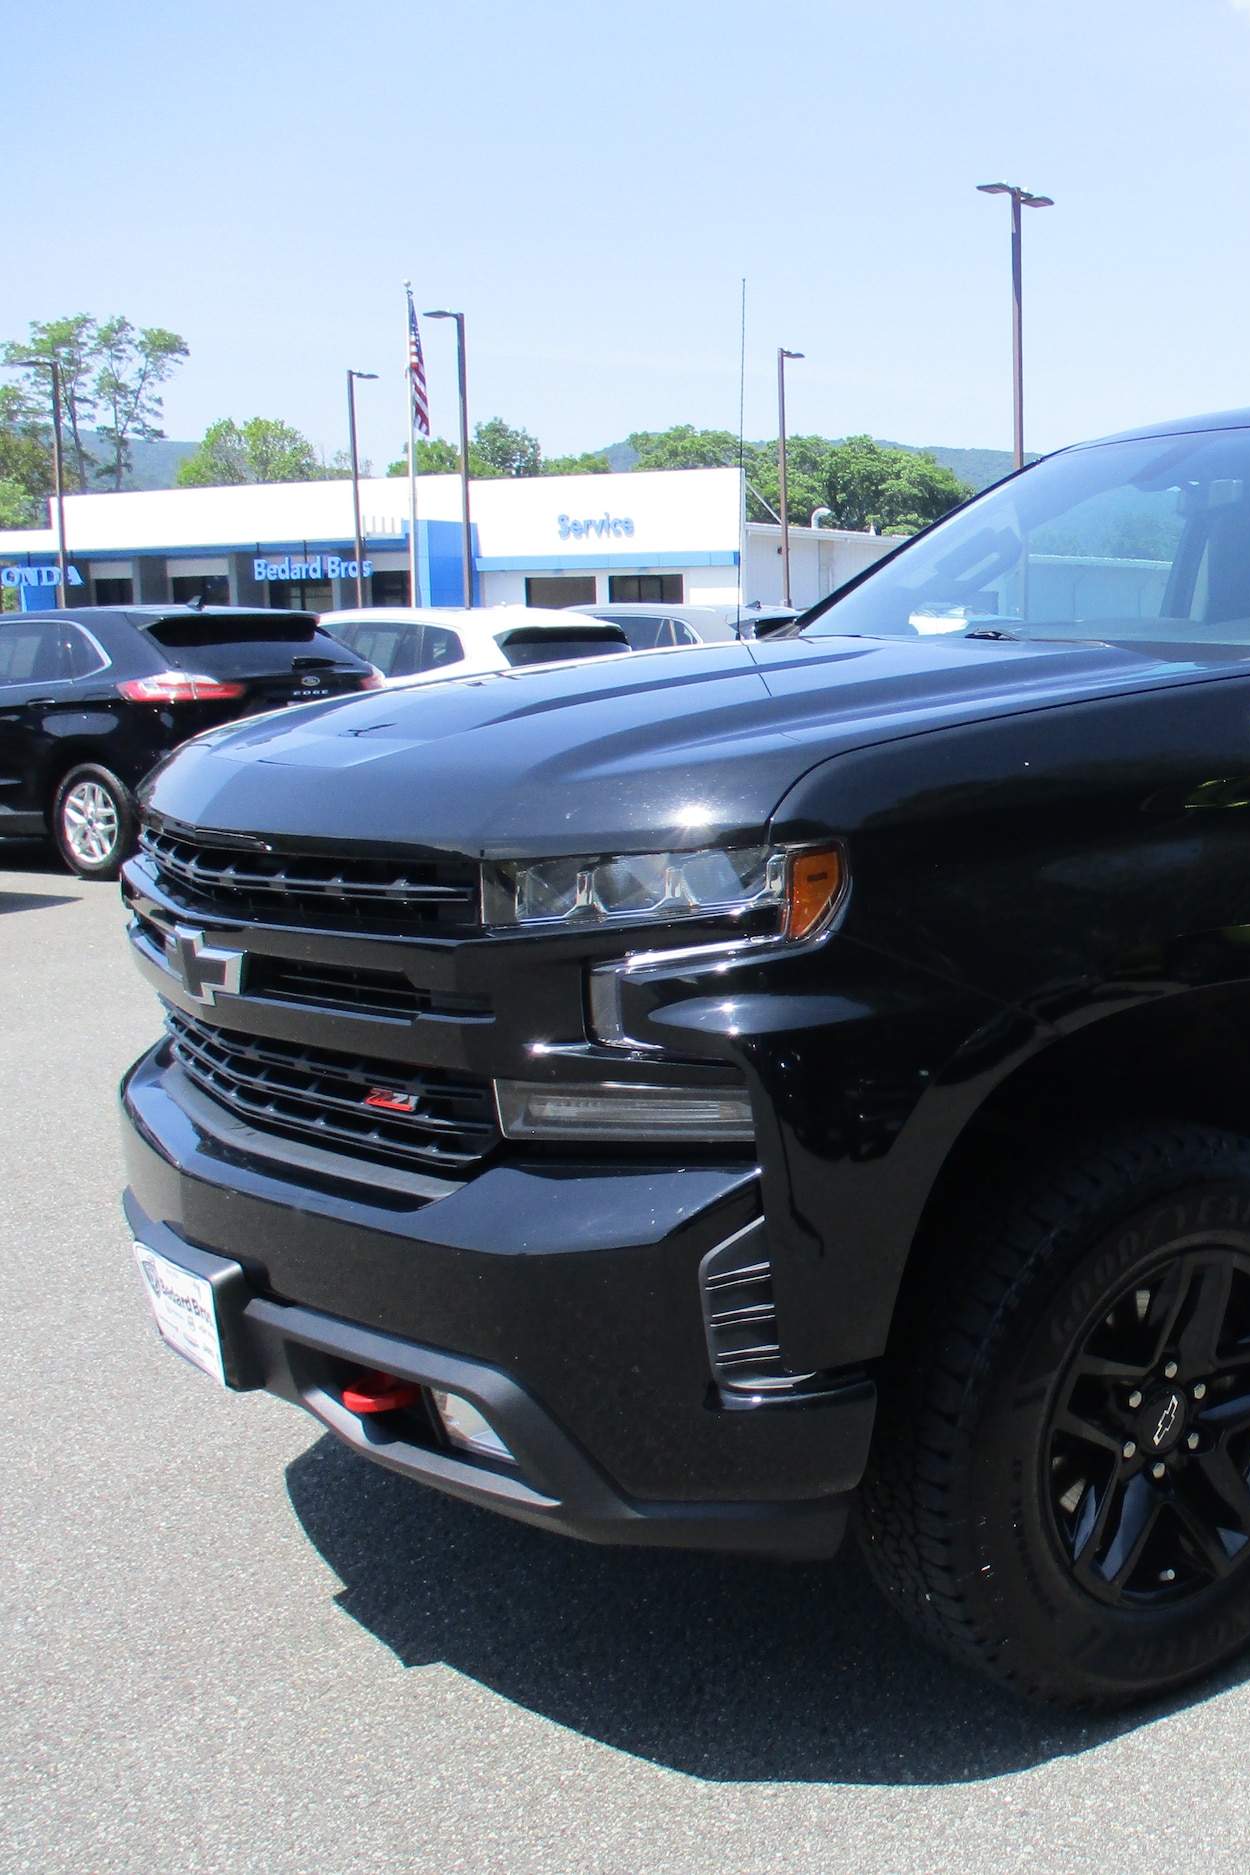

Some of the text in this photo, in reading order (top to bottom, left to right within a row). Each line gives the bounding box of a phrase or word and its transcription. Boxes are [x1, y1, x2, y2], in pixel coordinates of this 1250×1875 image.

[557, 511, 635, 539] Service
[253, 556, 373, 581] Bedard Bros
[366, 1087, 420, 1112] Z71
